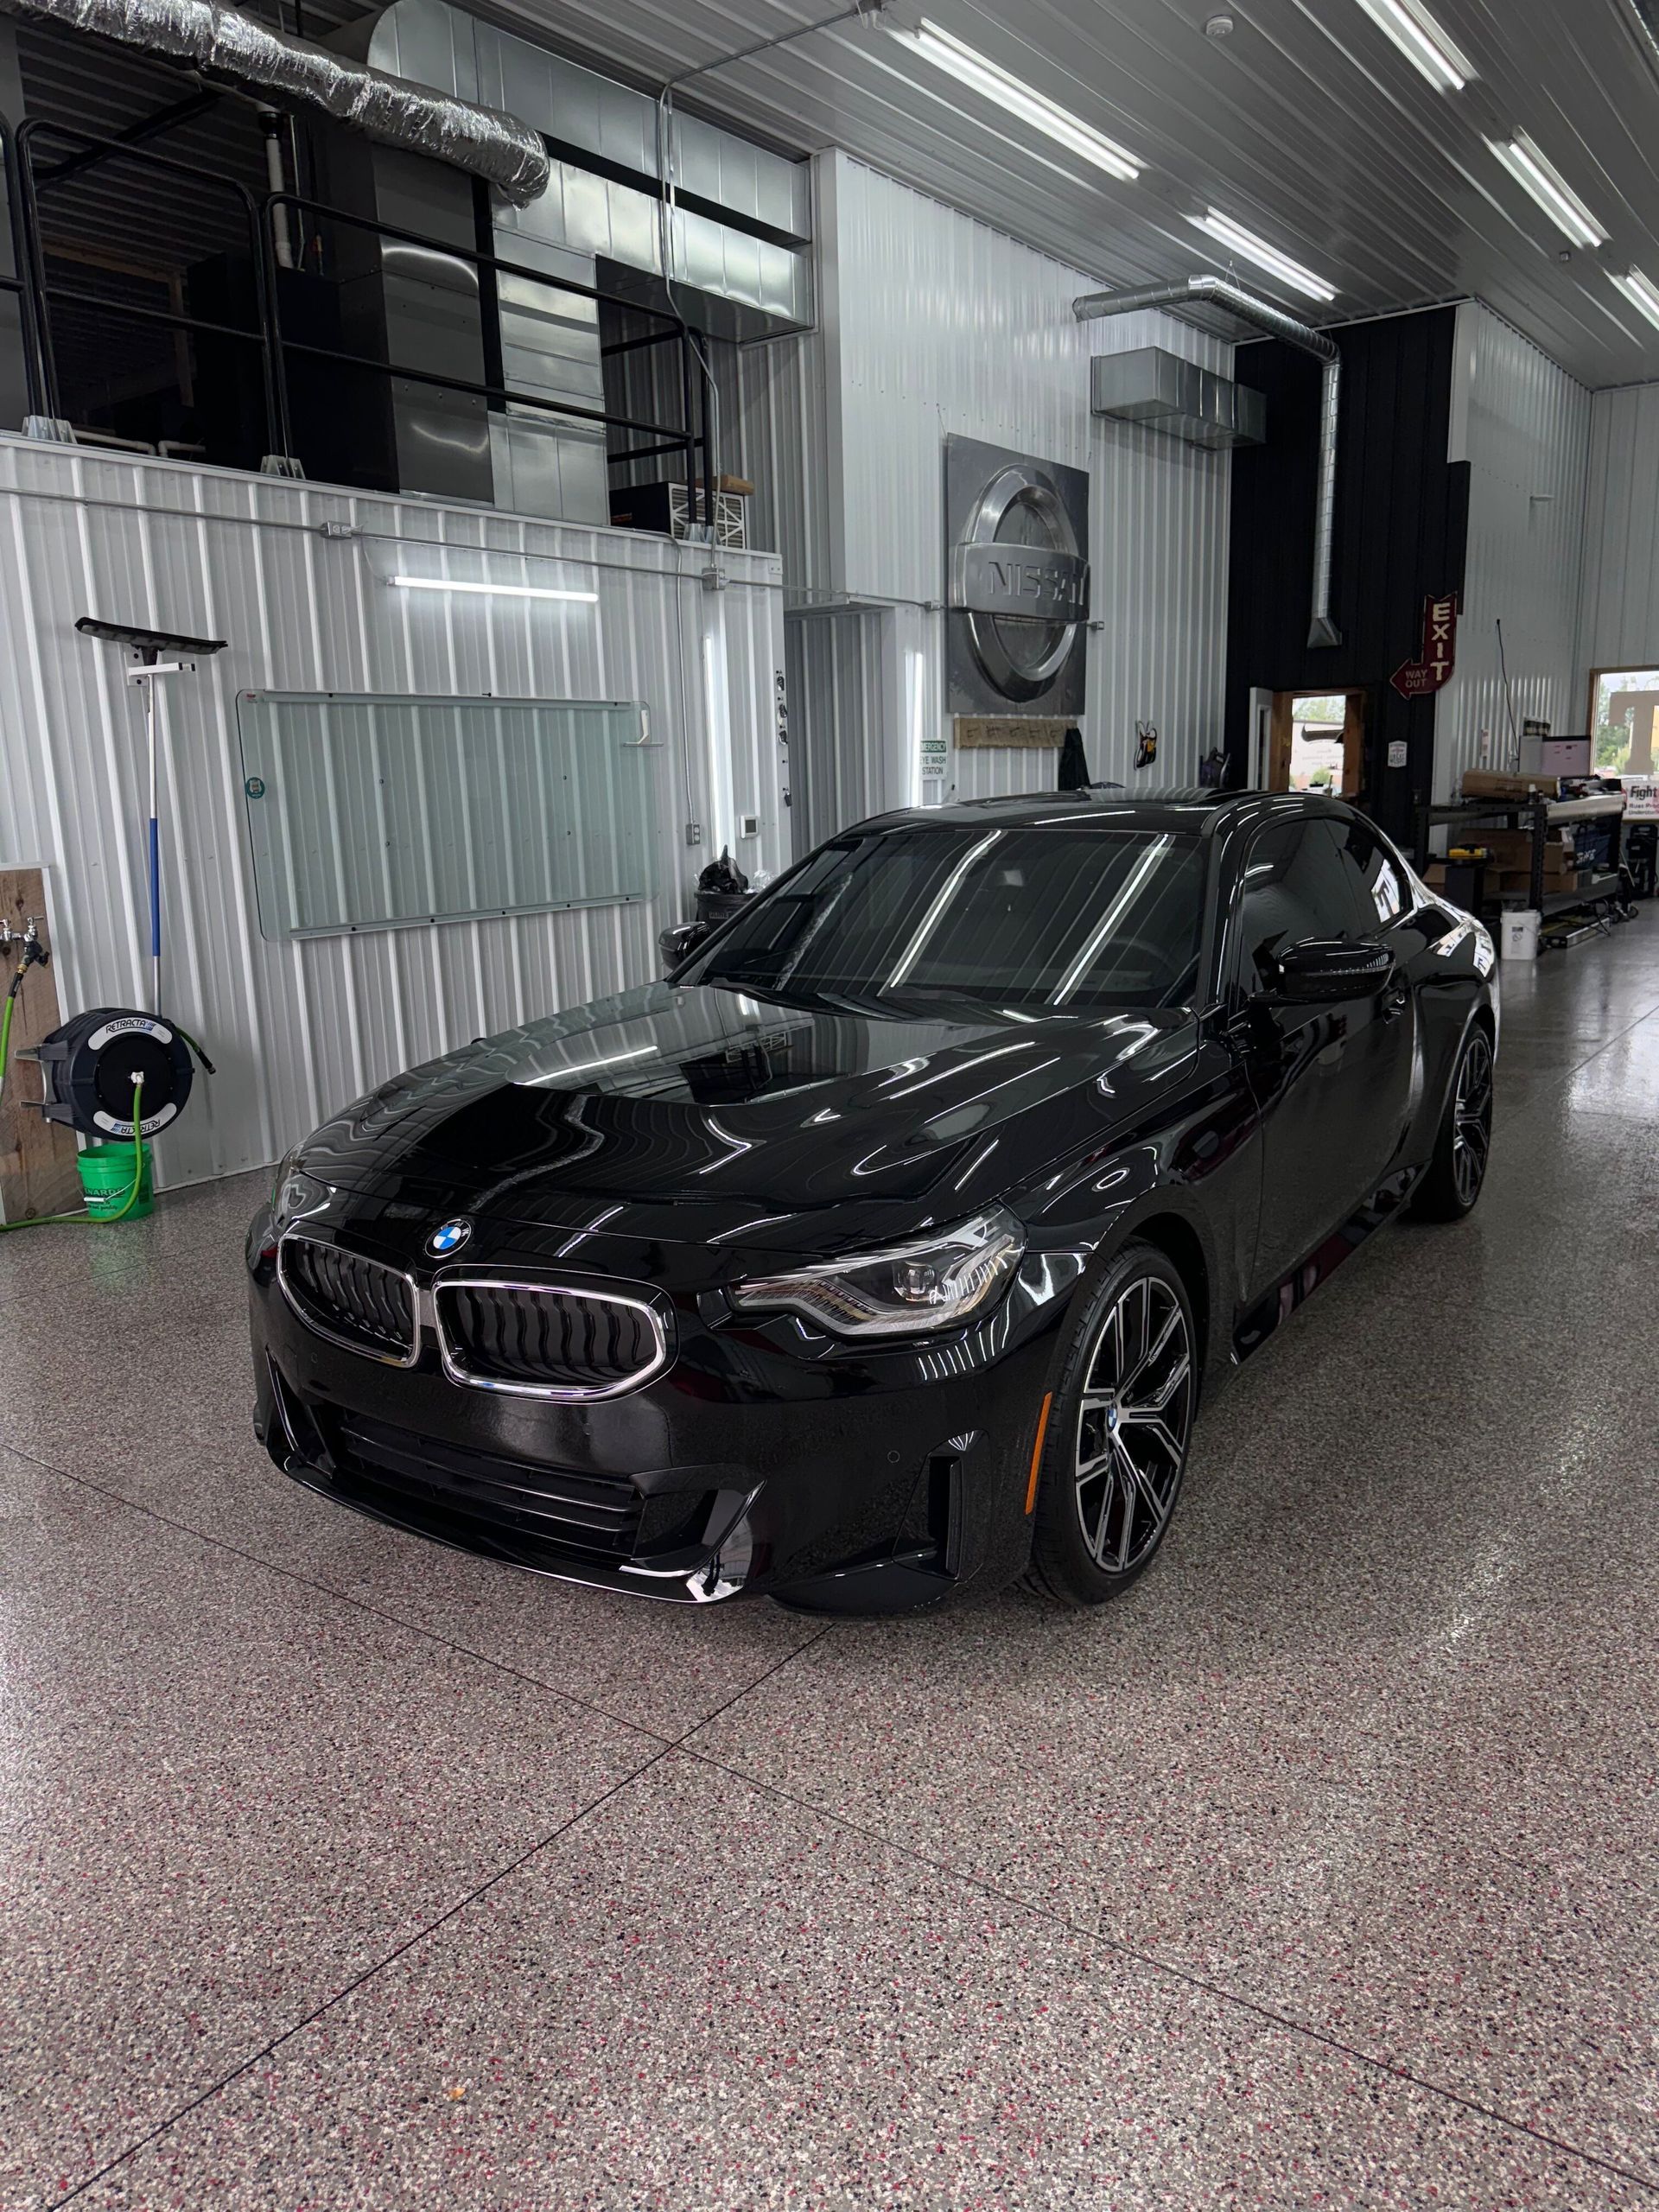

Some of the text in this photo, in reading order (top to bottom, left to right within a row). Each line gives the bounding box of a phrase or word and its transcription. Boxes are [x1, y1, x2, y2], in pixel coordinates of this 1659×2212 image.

[1430, 602, 1451, 681] EXIT
[1405, 670, 1427, 679] WAY
[1405, 679, 1427, 688] OUT
[931, 756, 946, 765] WASH
[922, 766, 944, 775] STATION
[1630, 785, 1657, 800] Fight
[105, 1019, 147, 1033] RETRACTA
[121, 1120, 161, 1135] RETRCTA
